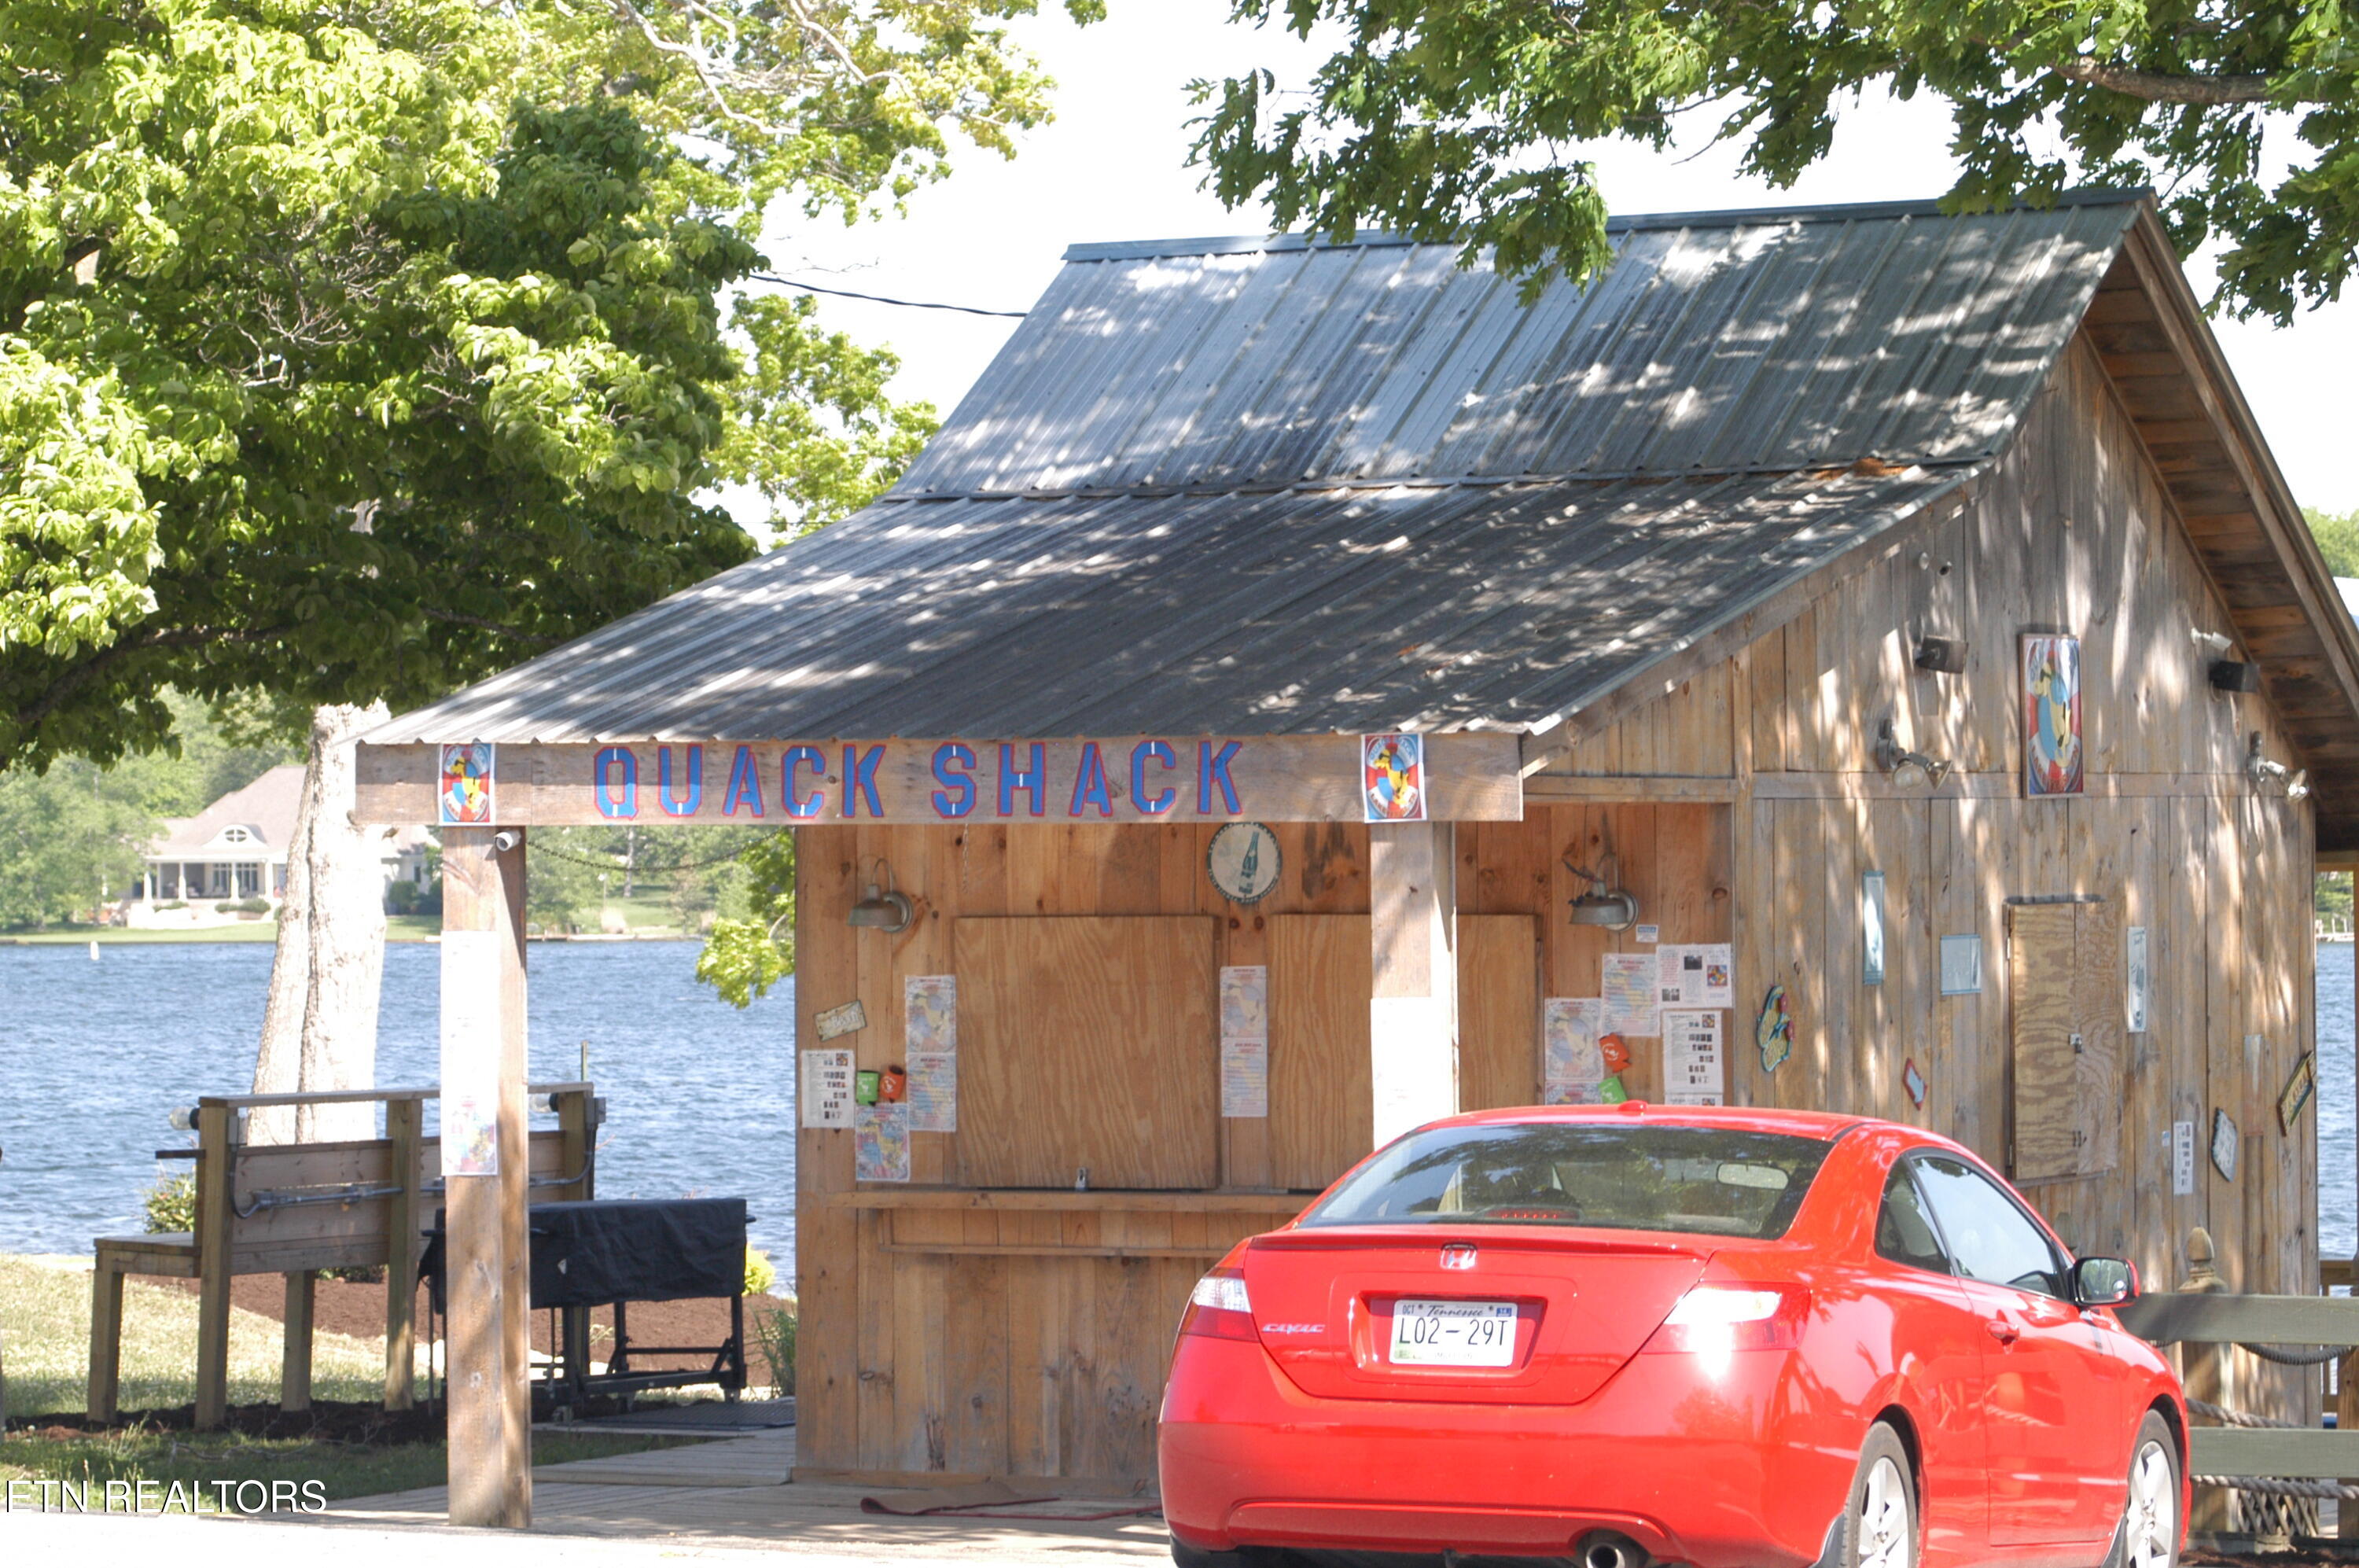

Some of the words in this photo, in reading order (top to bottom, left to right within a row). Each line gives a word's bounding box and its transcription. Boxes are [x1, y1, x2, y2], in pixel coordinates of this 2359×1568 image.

[594, 743, 886, 820] QUACK
[931, 740, 1243, 819] SHACK
[1402, 1305, 1415, 1315] OCT
[1427, 1305, 1484, 1317] Tennessee
